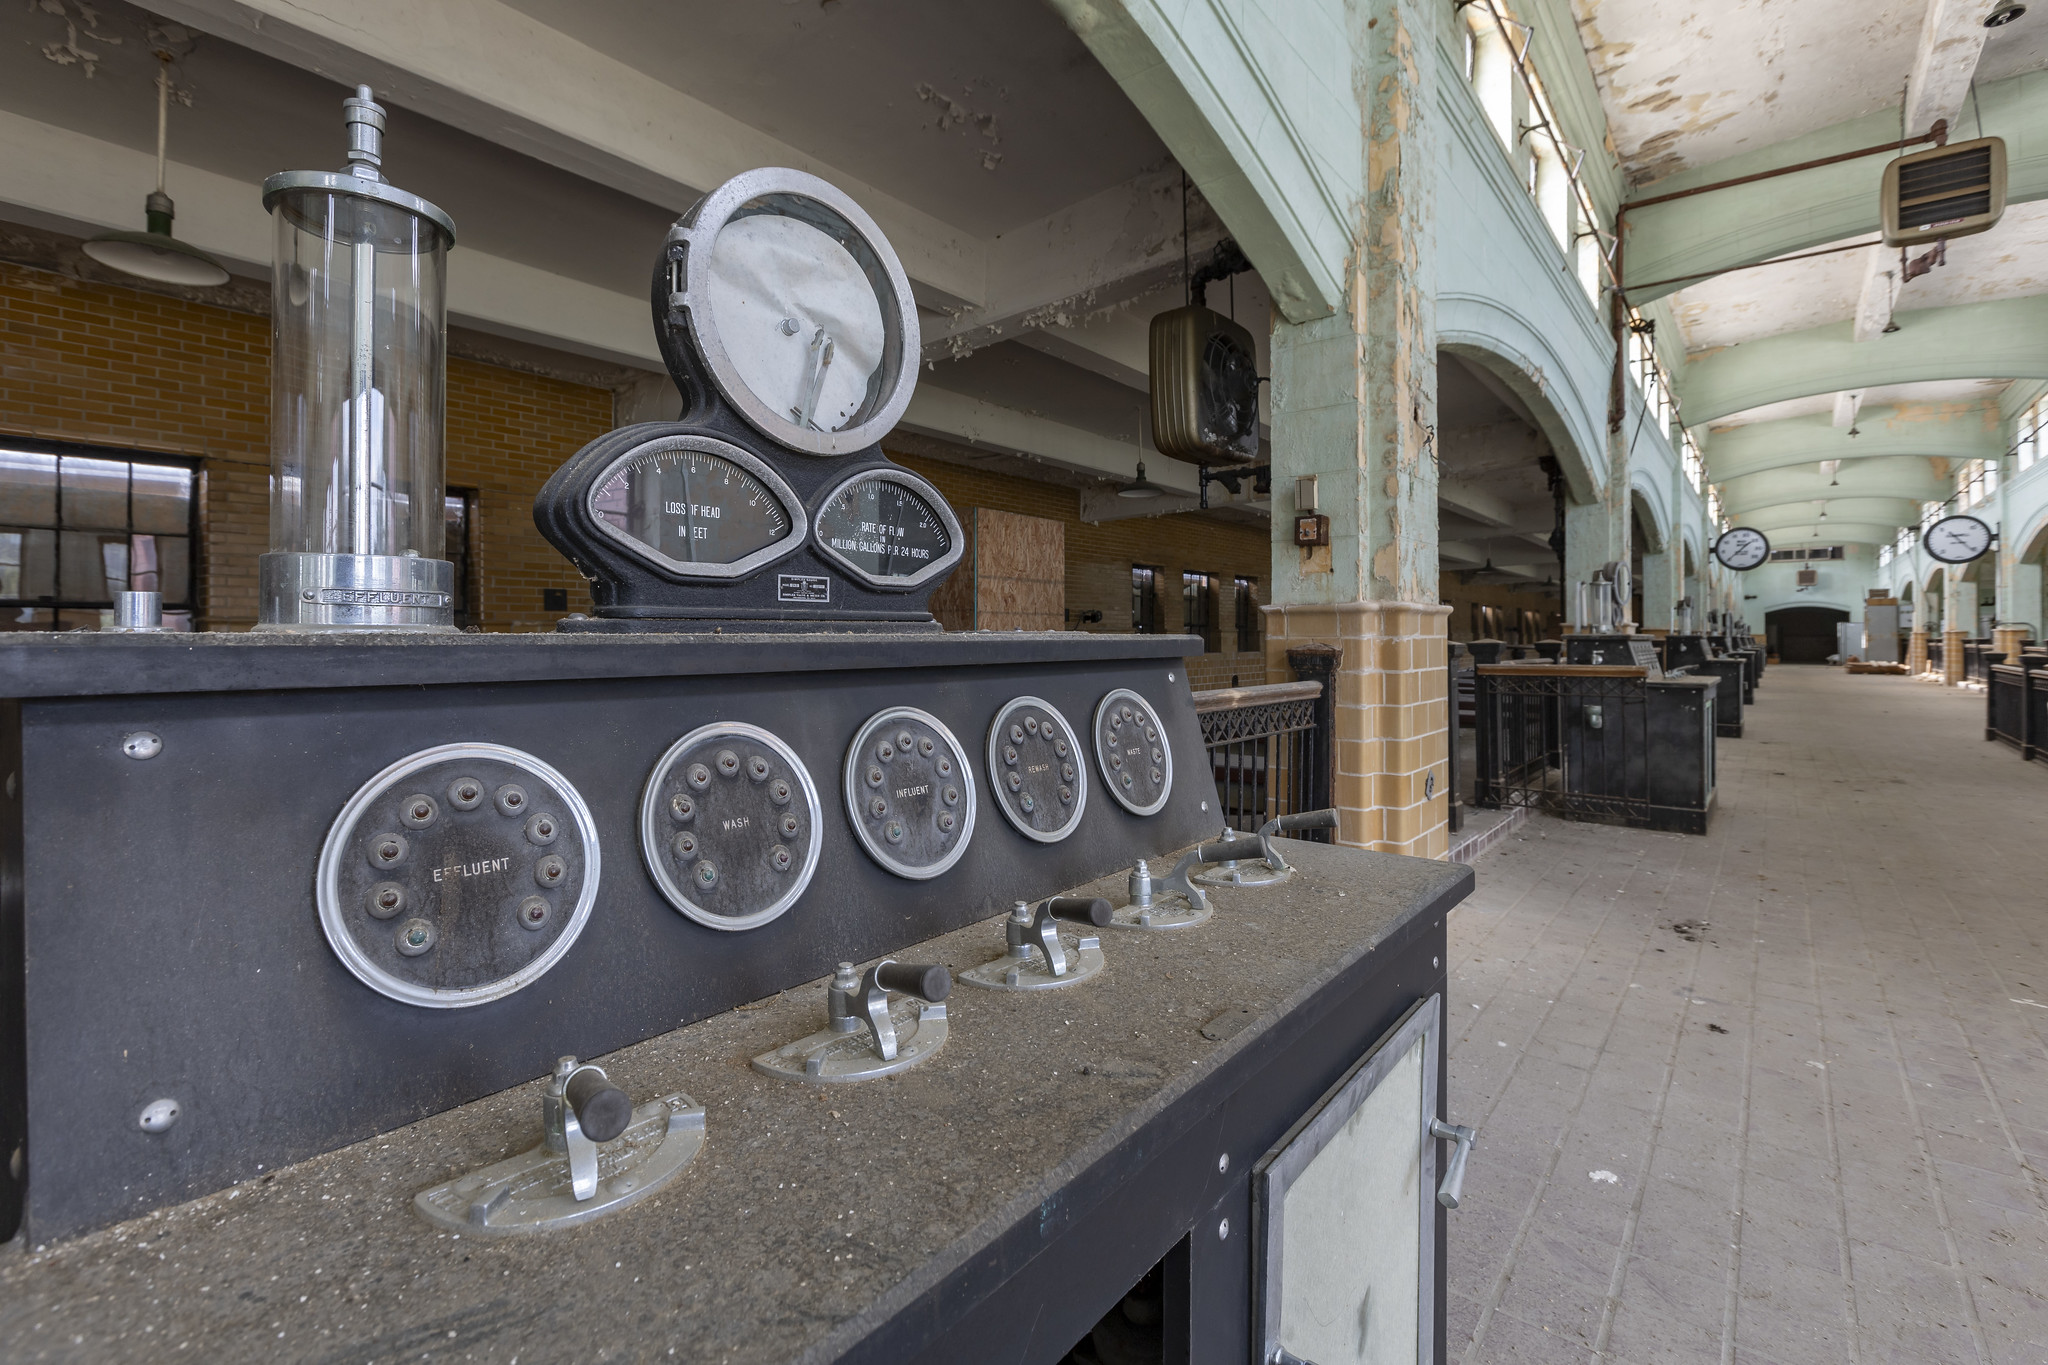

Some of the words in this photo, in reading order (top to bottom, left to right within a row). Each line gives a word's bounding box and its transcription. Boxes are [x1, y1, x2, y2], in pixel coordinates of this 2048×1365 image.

[656, 467, 662, 475] 4
[624, 482, 630, 490] 2
[724, 478, 730, 486] 8
[598, 511, 604, 519] 0
[665, 501, 686, 515] LOSS
[700, 505, 721, 519] HEAD
[678, 525, 686, 537] IN
[691, 526, 708, 539] EET
[861, 521, 876, 534] RATE
[878, 524, 887, 535] OF
[888, 525, 905, 538] FLW
[880, 535, 886, 543] IN
[831, 537, 857, 551] MILLION
[858, 541, 886, 555] GALLONS
[887, 545, 899, 556] PR
[900, 546, 909, 557] 24
[911, 547, 930, 560] HOURS
[343, 591, 430, 604] EFFLUENT
[1126, 747, 1141, 756] WASTE
[895, 784, 929, 799] INFLUENT
[722, 816, 750, 831] WASH
[433, 857, 510, 882] EFFLUENT
